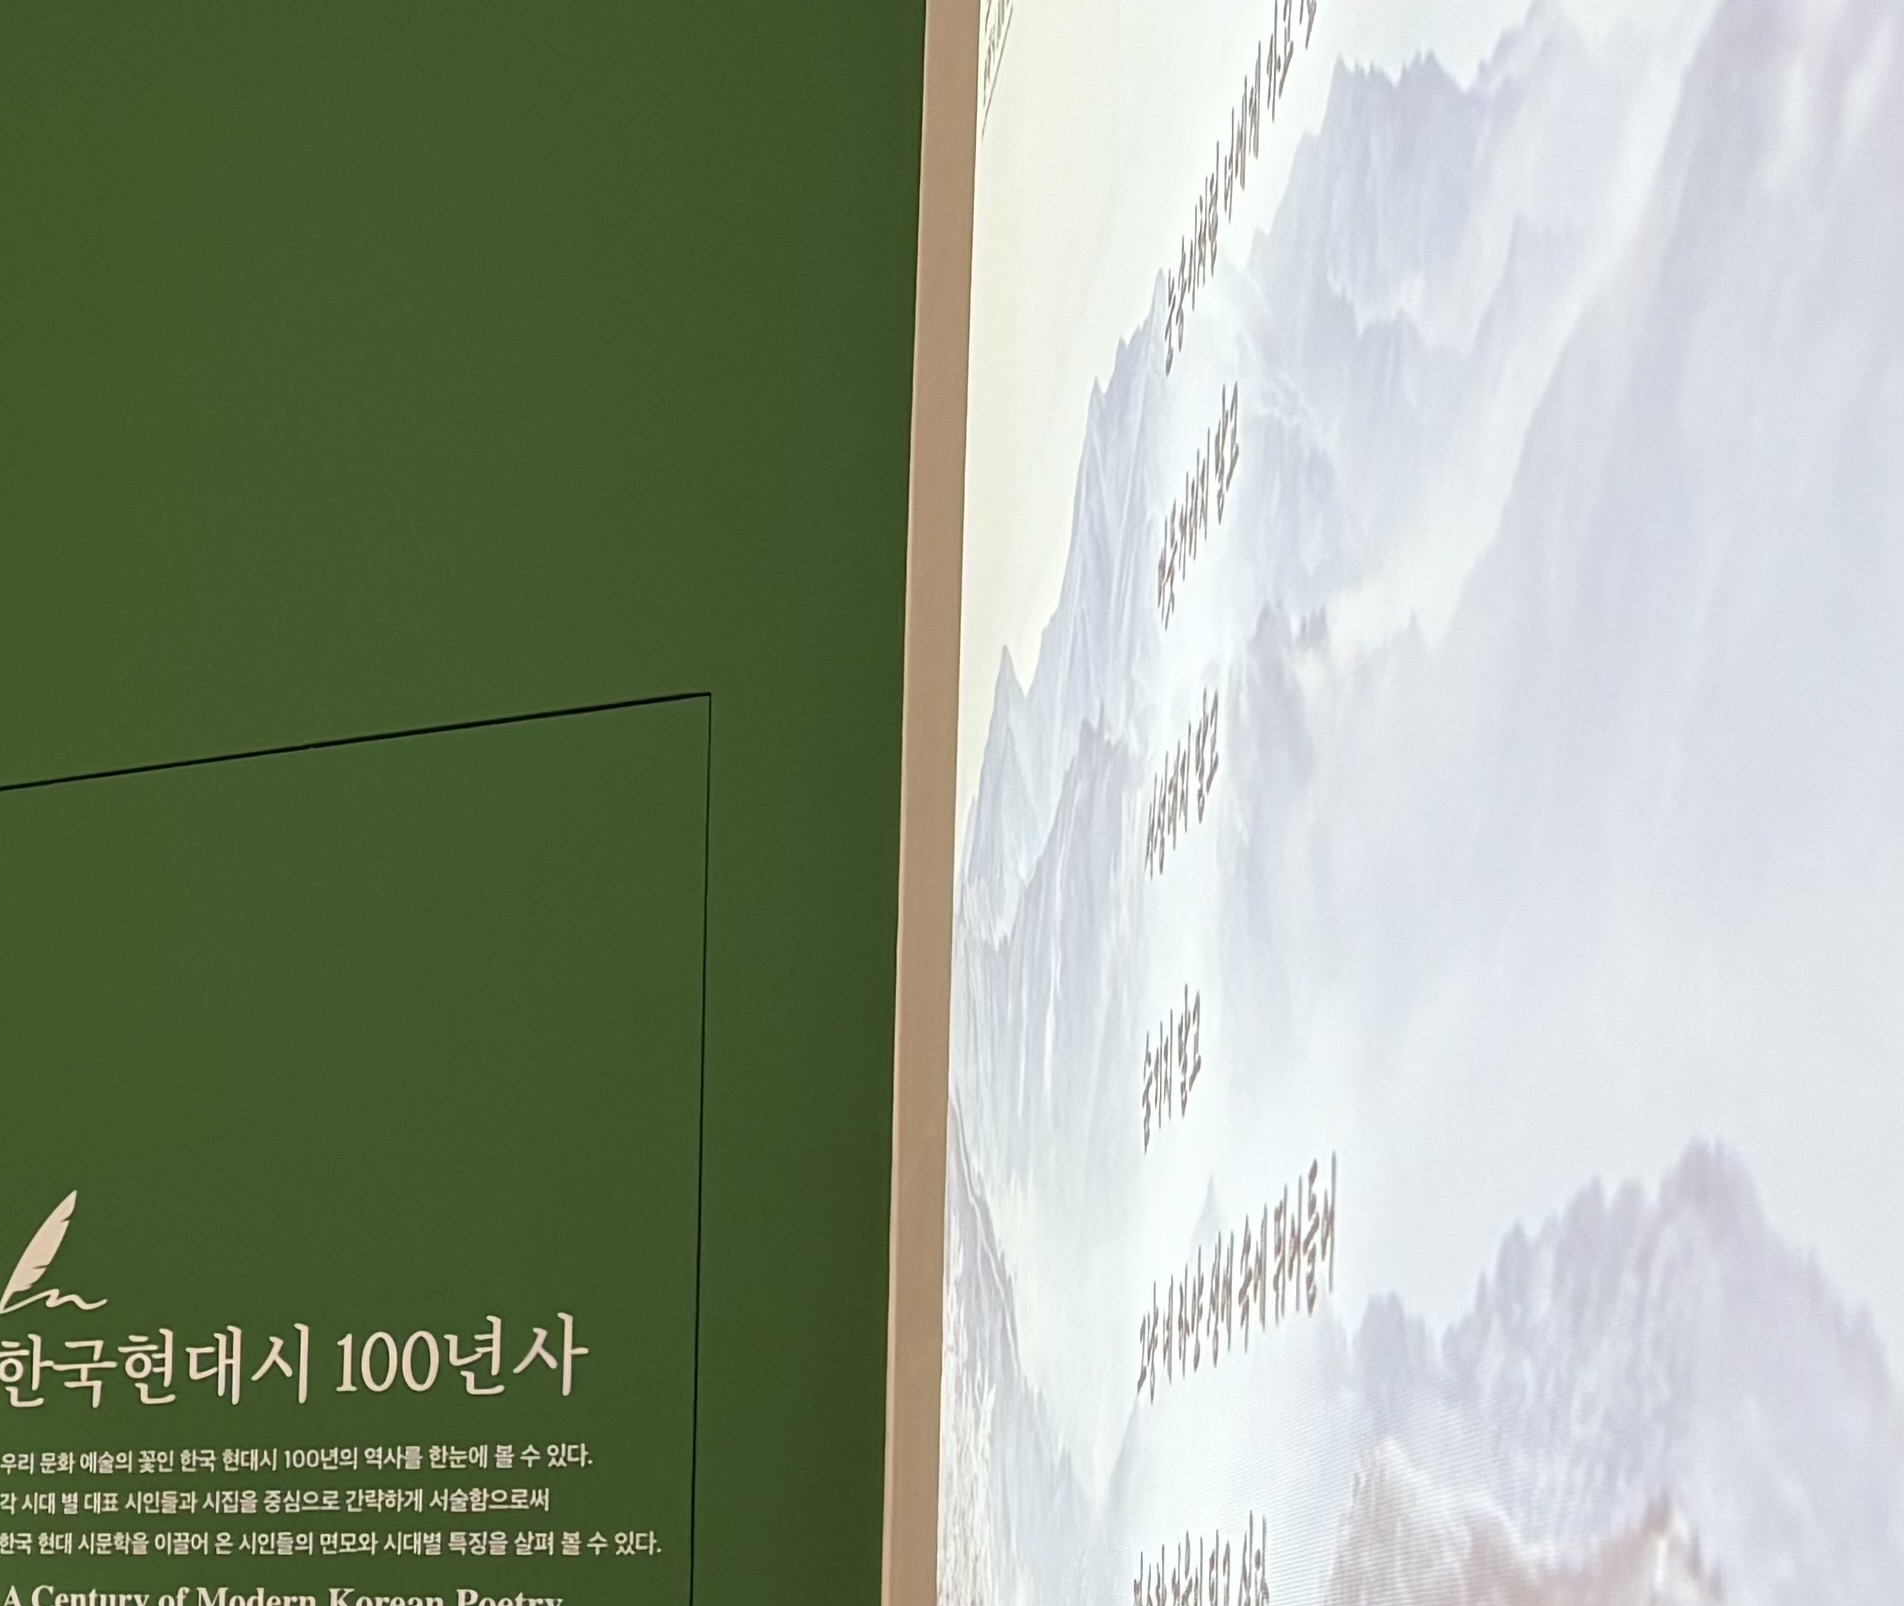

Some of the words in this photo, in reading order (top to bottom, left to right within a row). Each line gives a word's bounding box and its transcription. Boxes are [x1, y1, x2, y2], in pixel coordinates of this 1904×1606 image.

[1178, 982, 1201, 1118] 말고
[336, 1312, 589, 1397] 100년사
[0, 1452, 35, 1475] 우리
[39, 1451, 76, 1475] 문화
[79, 1450, 133, 1474] 예술의
[137, 1449, 174, 1474] 꽃인
[179, 1449, 217, 1473] 한국
[222, 1447, 278, 1472] 현대시
[284, 1446, 358, 1471] 100년의
[364, 1445, 424, 1470] 역사를
[428, 1444, 488, 1469] 한눈에
[494, 1444, 515, 1469] 볼
[519, 1444, 541, 1468] 수
[546, 1442, 593, 1468] 있다.
[0, 1492, 18, 1516] 각
[21, 1491, 56, 1515] 시대
[83, 1491, 119, 1515] 대표
[124, 1490, 199, 1514] 시인들과
[202, 1489, 259, 1514] 시집을
[263, 1489, 341, 1514] 중심으로
[345, 1488, 424, 1513] 간략하게
[429, 1487, 550, 1513] 서술함으로써
[37, 1532, 73, 1555] 현대
[77, 1531, 150, 1555] 시문학을
[154, 1531, 209, 1556] 이끌어
[214, 1531, 234, 1555] 온
[238, 1531, 314, 1556] 시인들의
[319, 1531, 379, 1556] 면모와
[383, 1531, 442, 1556] 시대별
[447, 1530, 509, 1556] 특징을
[514, 1530, 554, 1556] 살펴
[561, 1531, 582, 1556] 볼
[586, 1531, 609, 1556] 수
[614, 1530, 662, 1556] 있다.
